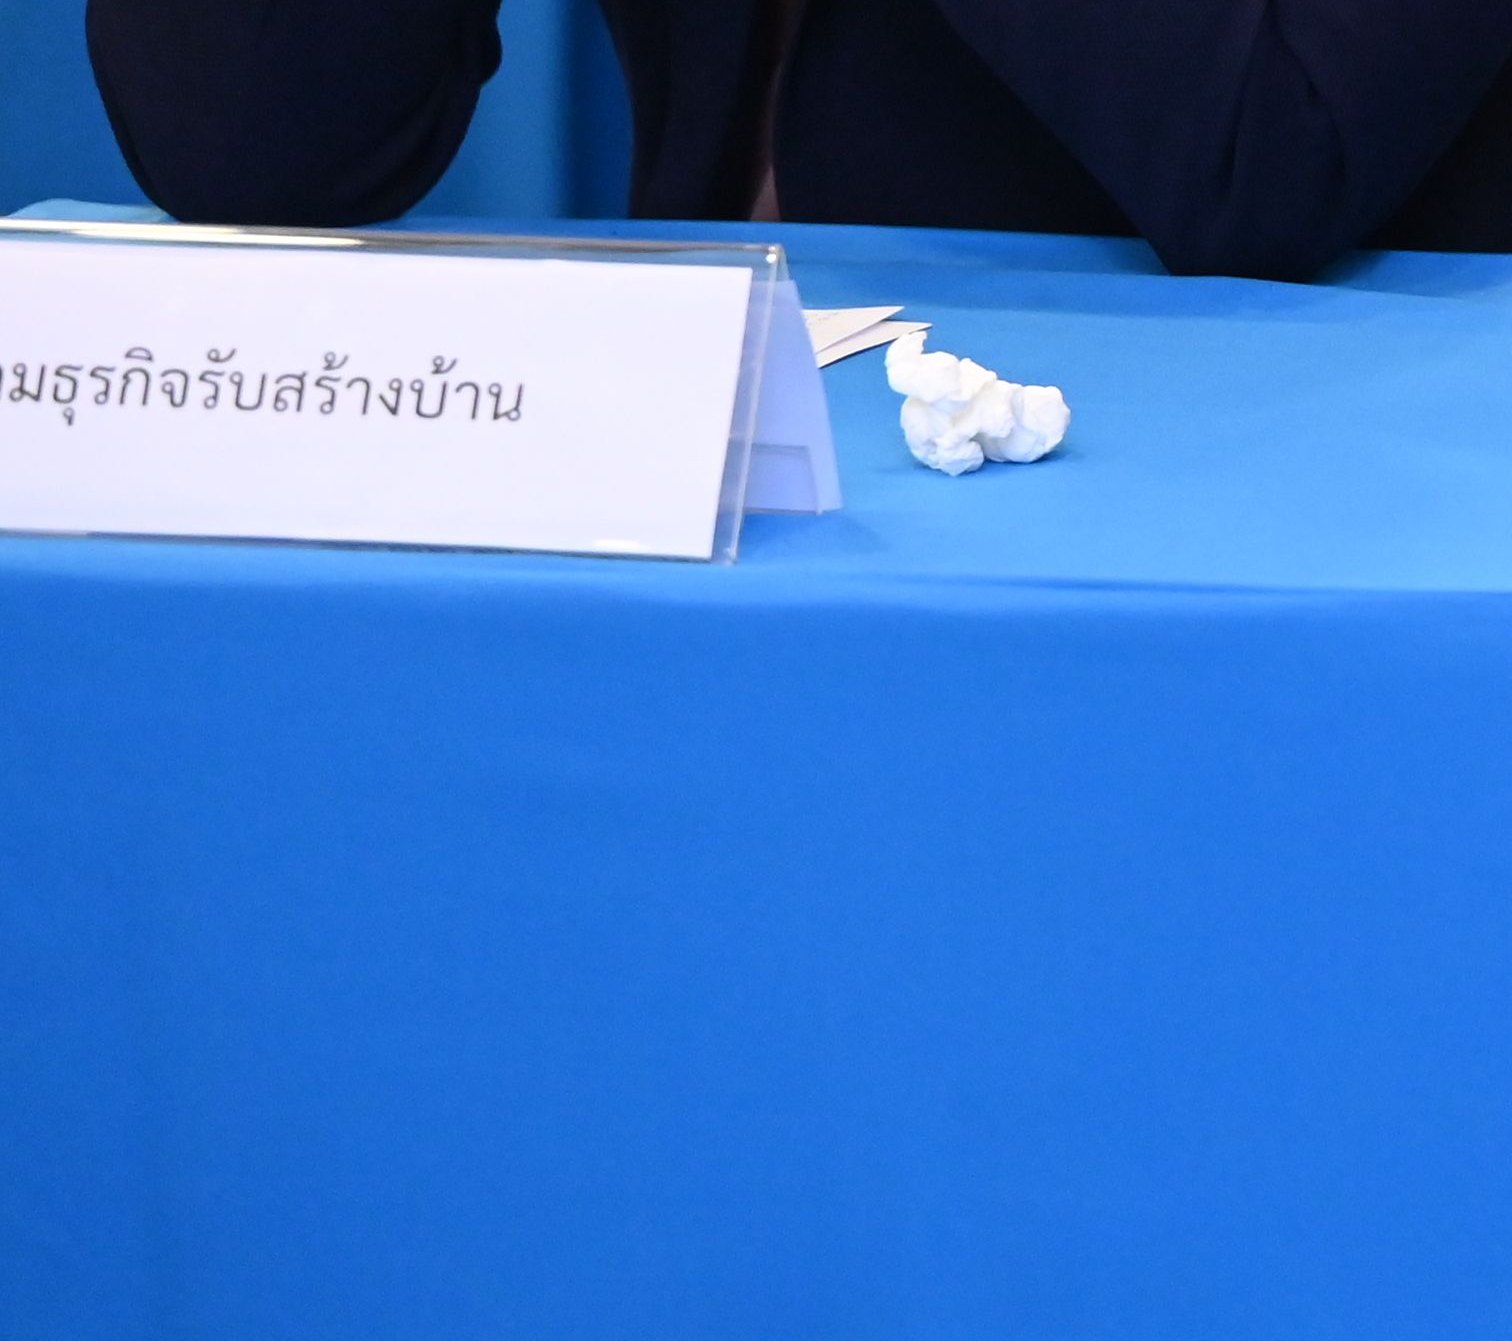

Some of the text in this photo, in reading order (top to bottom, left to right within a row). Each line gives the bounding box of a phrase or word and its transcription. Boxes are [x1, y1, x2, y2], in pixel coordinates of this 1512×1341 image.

[0, 346, 523, 427] มธุรกิจรับสร้างบ้าน
